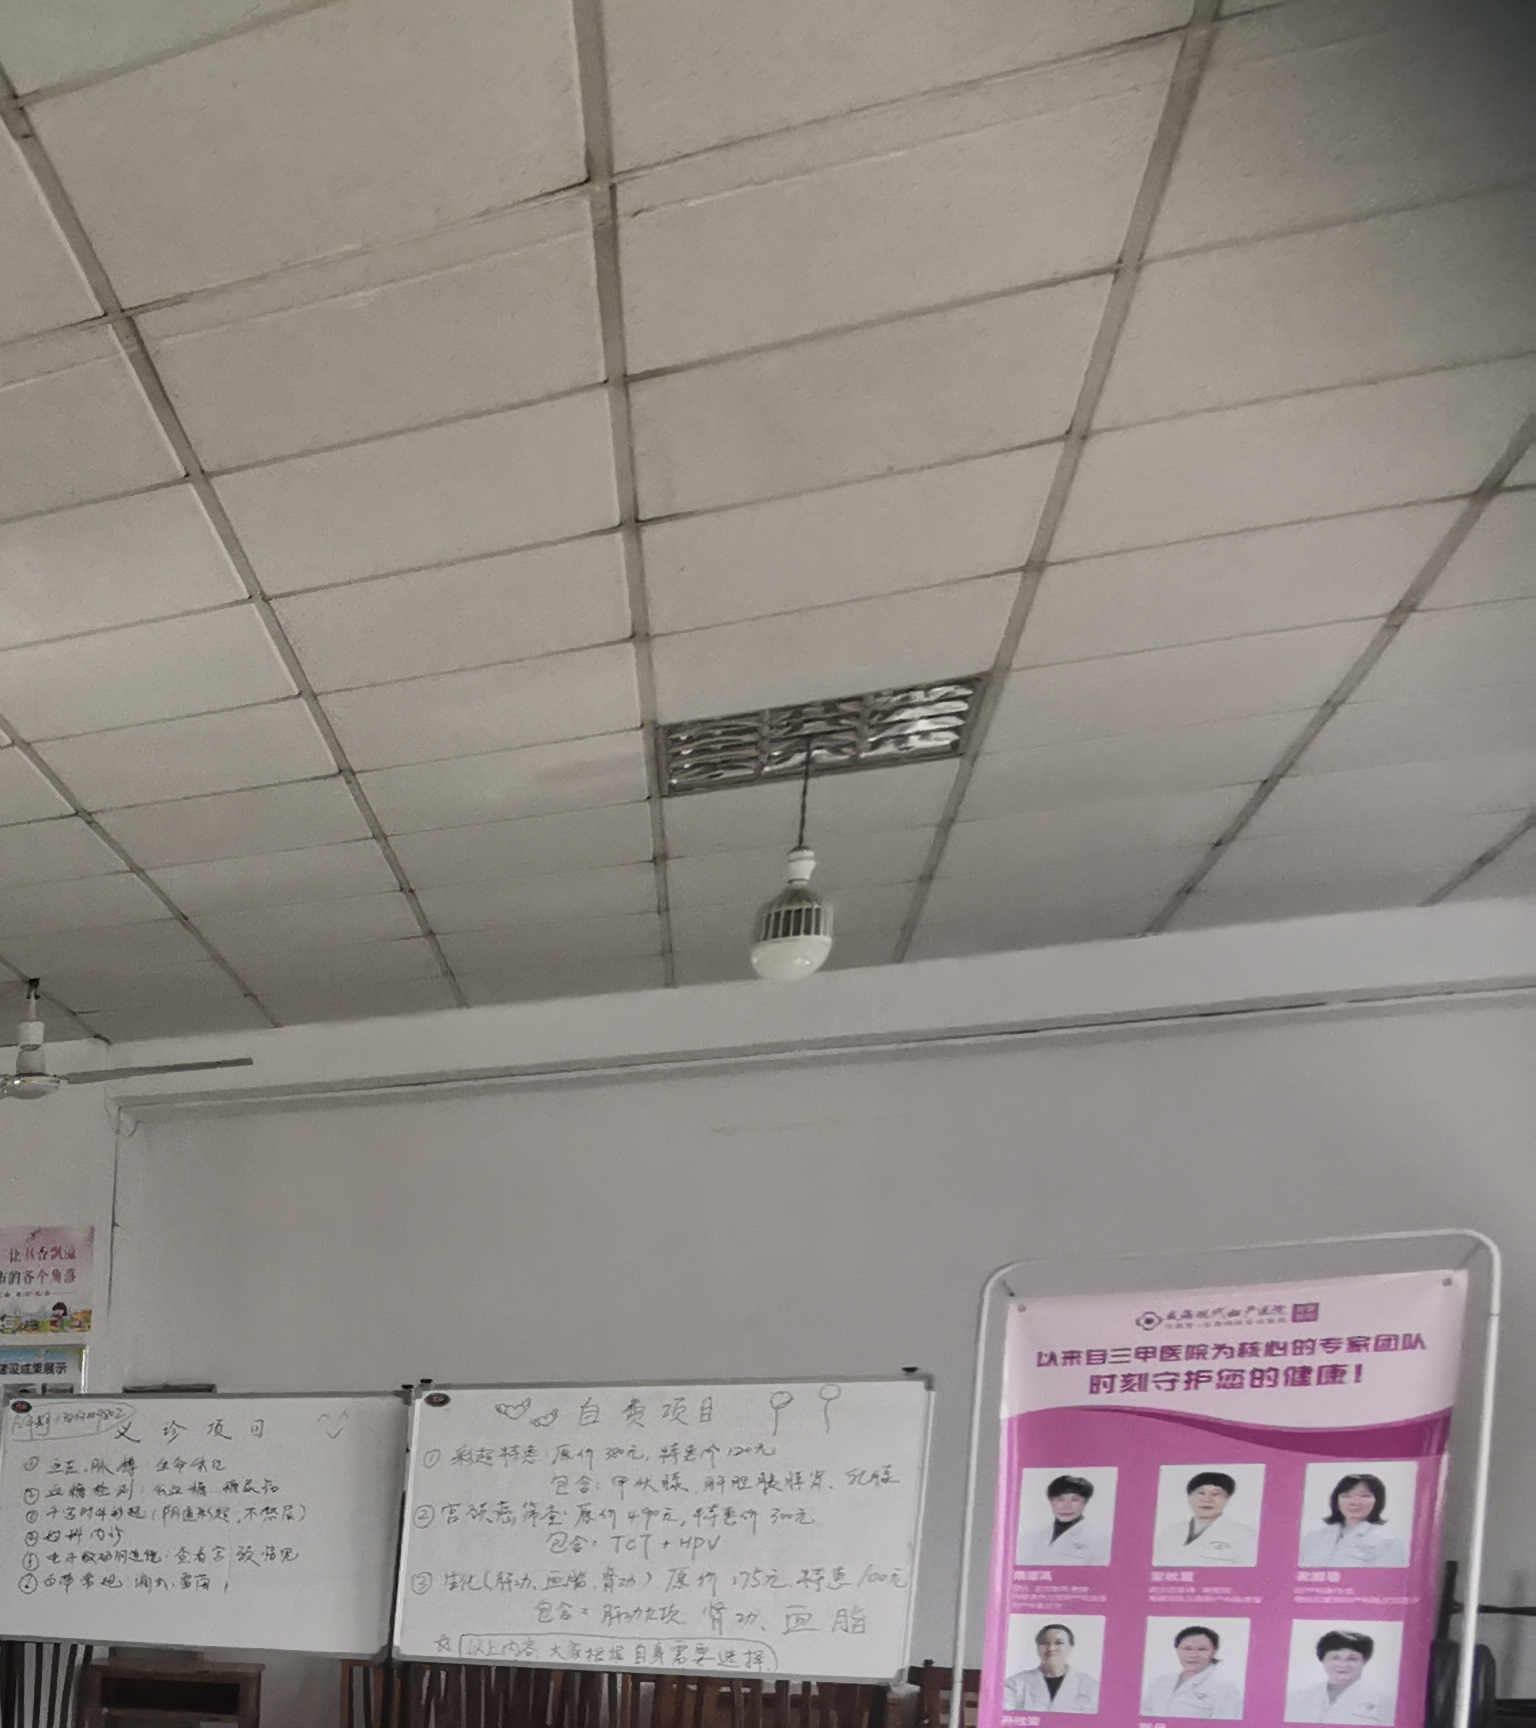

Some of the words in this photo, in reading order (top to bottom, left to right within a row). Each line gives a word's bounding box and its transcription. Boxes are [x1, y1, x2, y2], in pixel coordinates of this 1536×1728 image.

[1036, 1332, 1427, 1368] 以来自三甲医院为核心的专家团队
